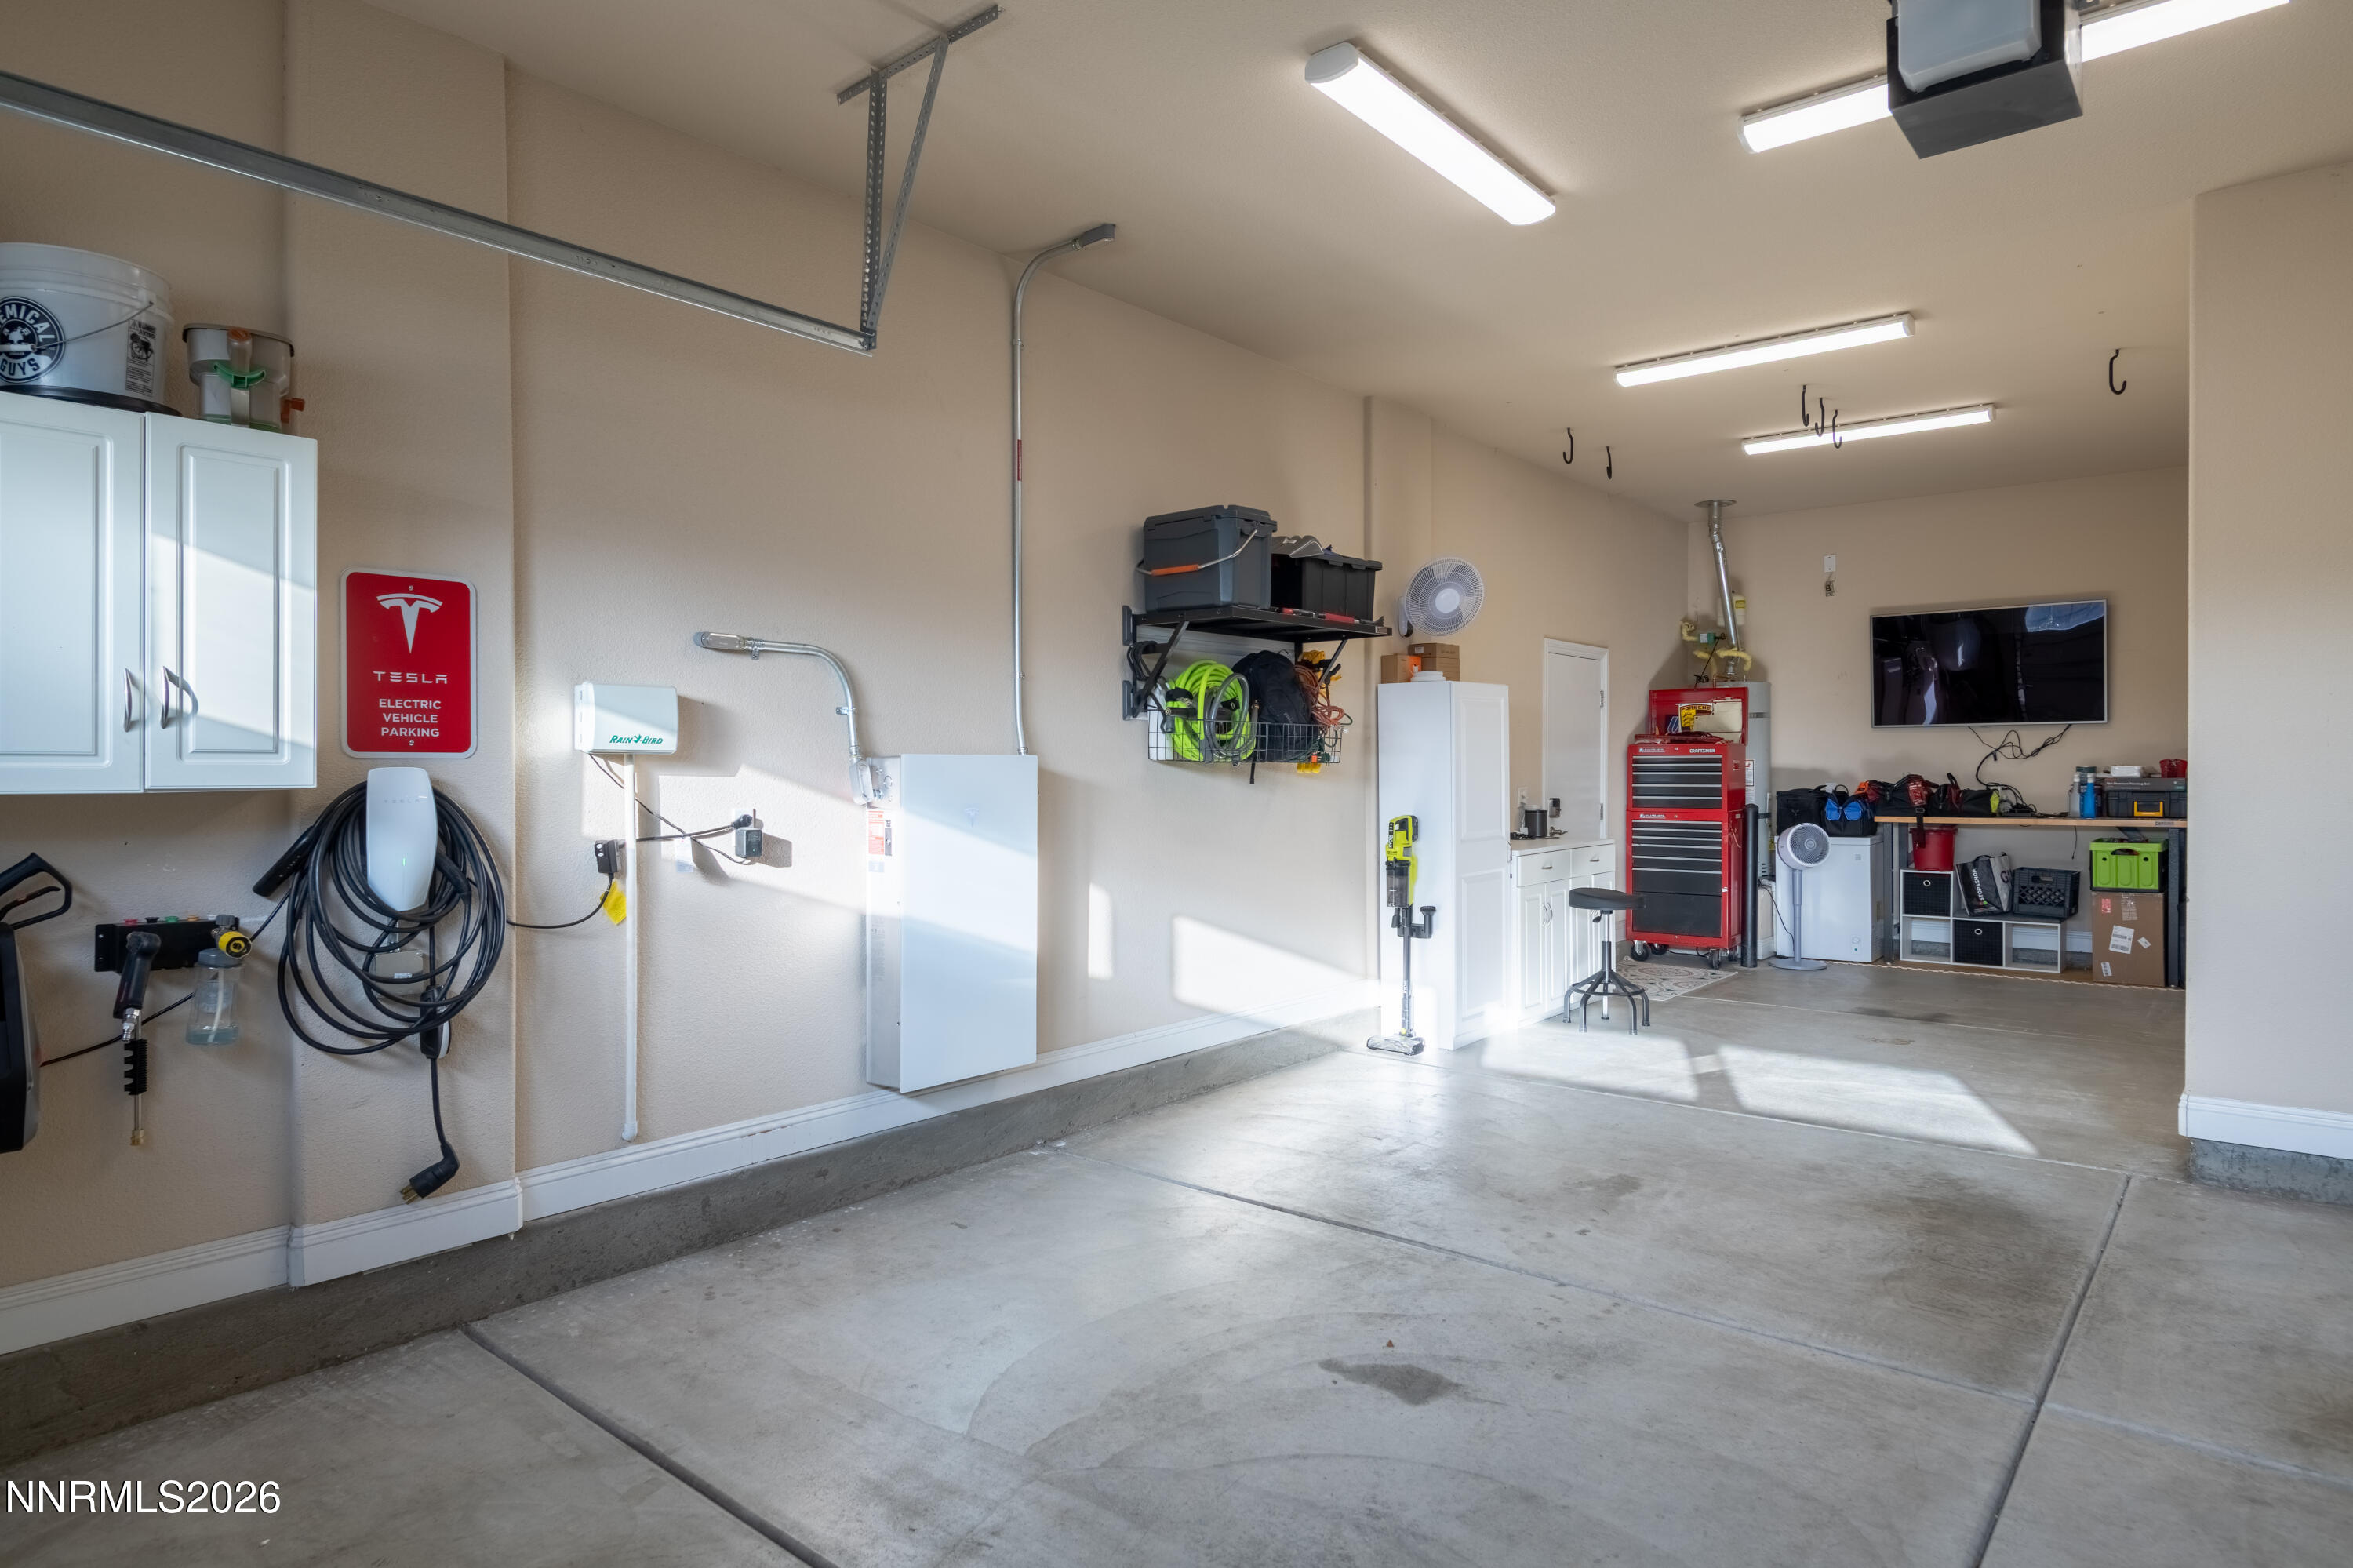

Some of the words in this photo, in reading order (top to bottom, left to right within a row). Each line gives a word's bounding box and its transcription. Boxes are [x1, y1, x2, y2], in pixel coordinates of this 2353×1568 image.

[0, 304, 56, 343] EMICAL
[0, 358, 41, 377] GUYS
[373, 671, 448, 685] TESLA
[379, 698, 442, 710] ELECTRIC
[382, 712, 438, 723] VEHICLE
[380, 726, 440, 737] PARKING
[609, 735, 633, 744] RAIN
[642, 735, 664, 744] BIRD
